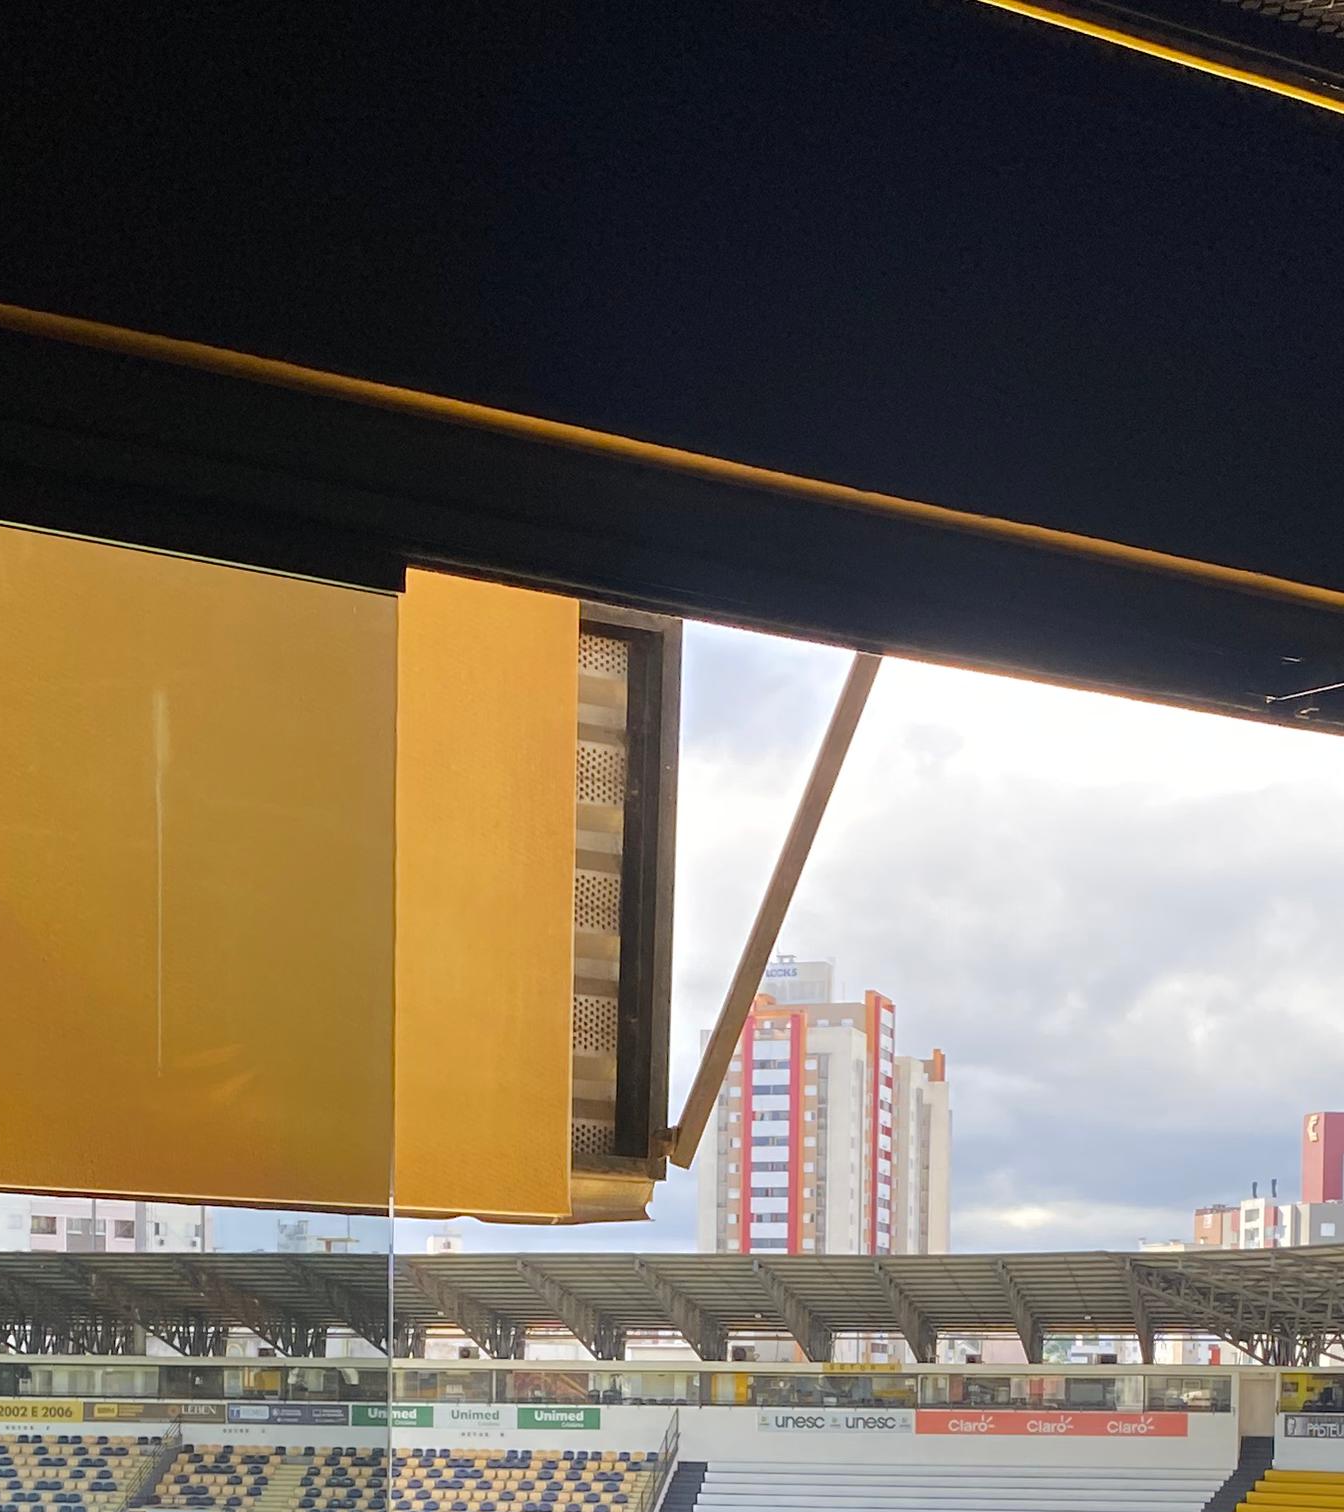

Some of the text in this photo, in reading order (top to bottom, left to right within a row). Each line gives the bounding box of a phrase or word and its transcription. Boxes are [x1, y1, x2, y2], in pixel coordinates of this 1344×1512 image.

[31, 1406, 39, 1417] E
[41, 1406, 73, 1418] 2006
[451, 1409, 500, 1420] Unimed
[534, 1410, 584, 1421] Unimed
[775, 1415, 825, 1429] unesc
[845, 1415, 896, 1429] unesc
[948, 1418, 990, 1432] Claro
[1026, 1418, 1067, 1433] Claro
[1106, 1419, 1148, 1434] Claro
